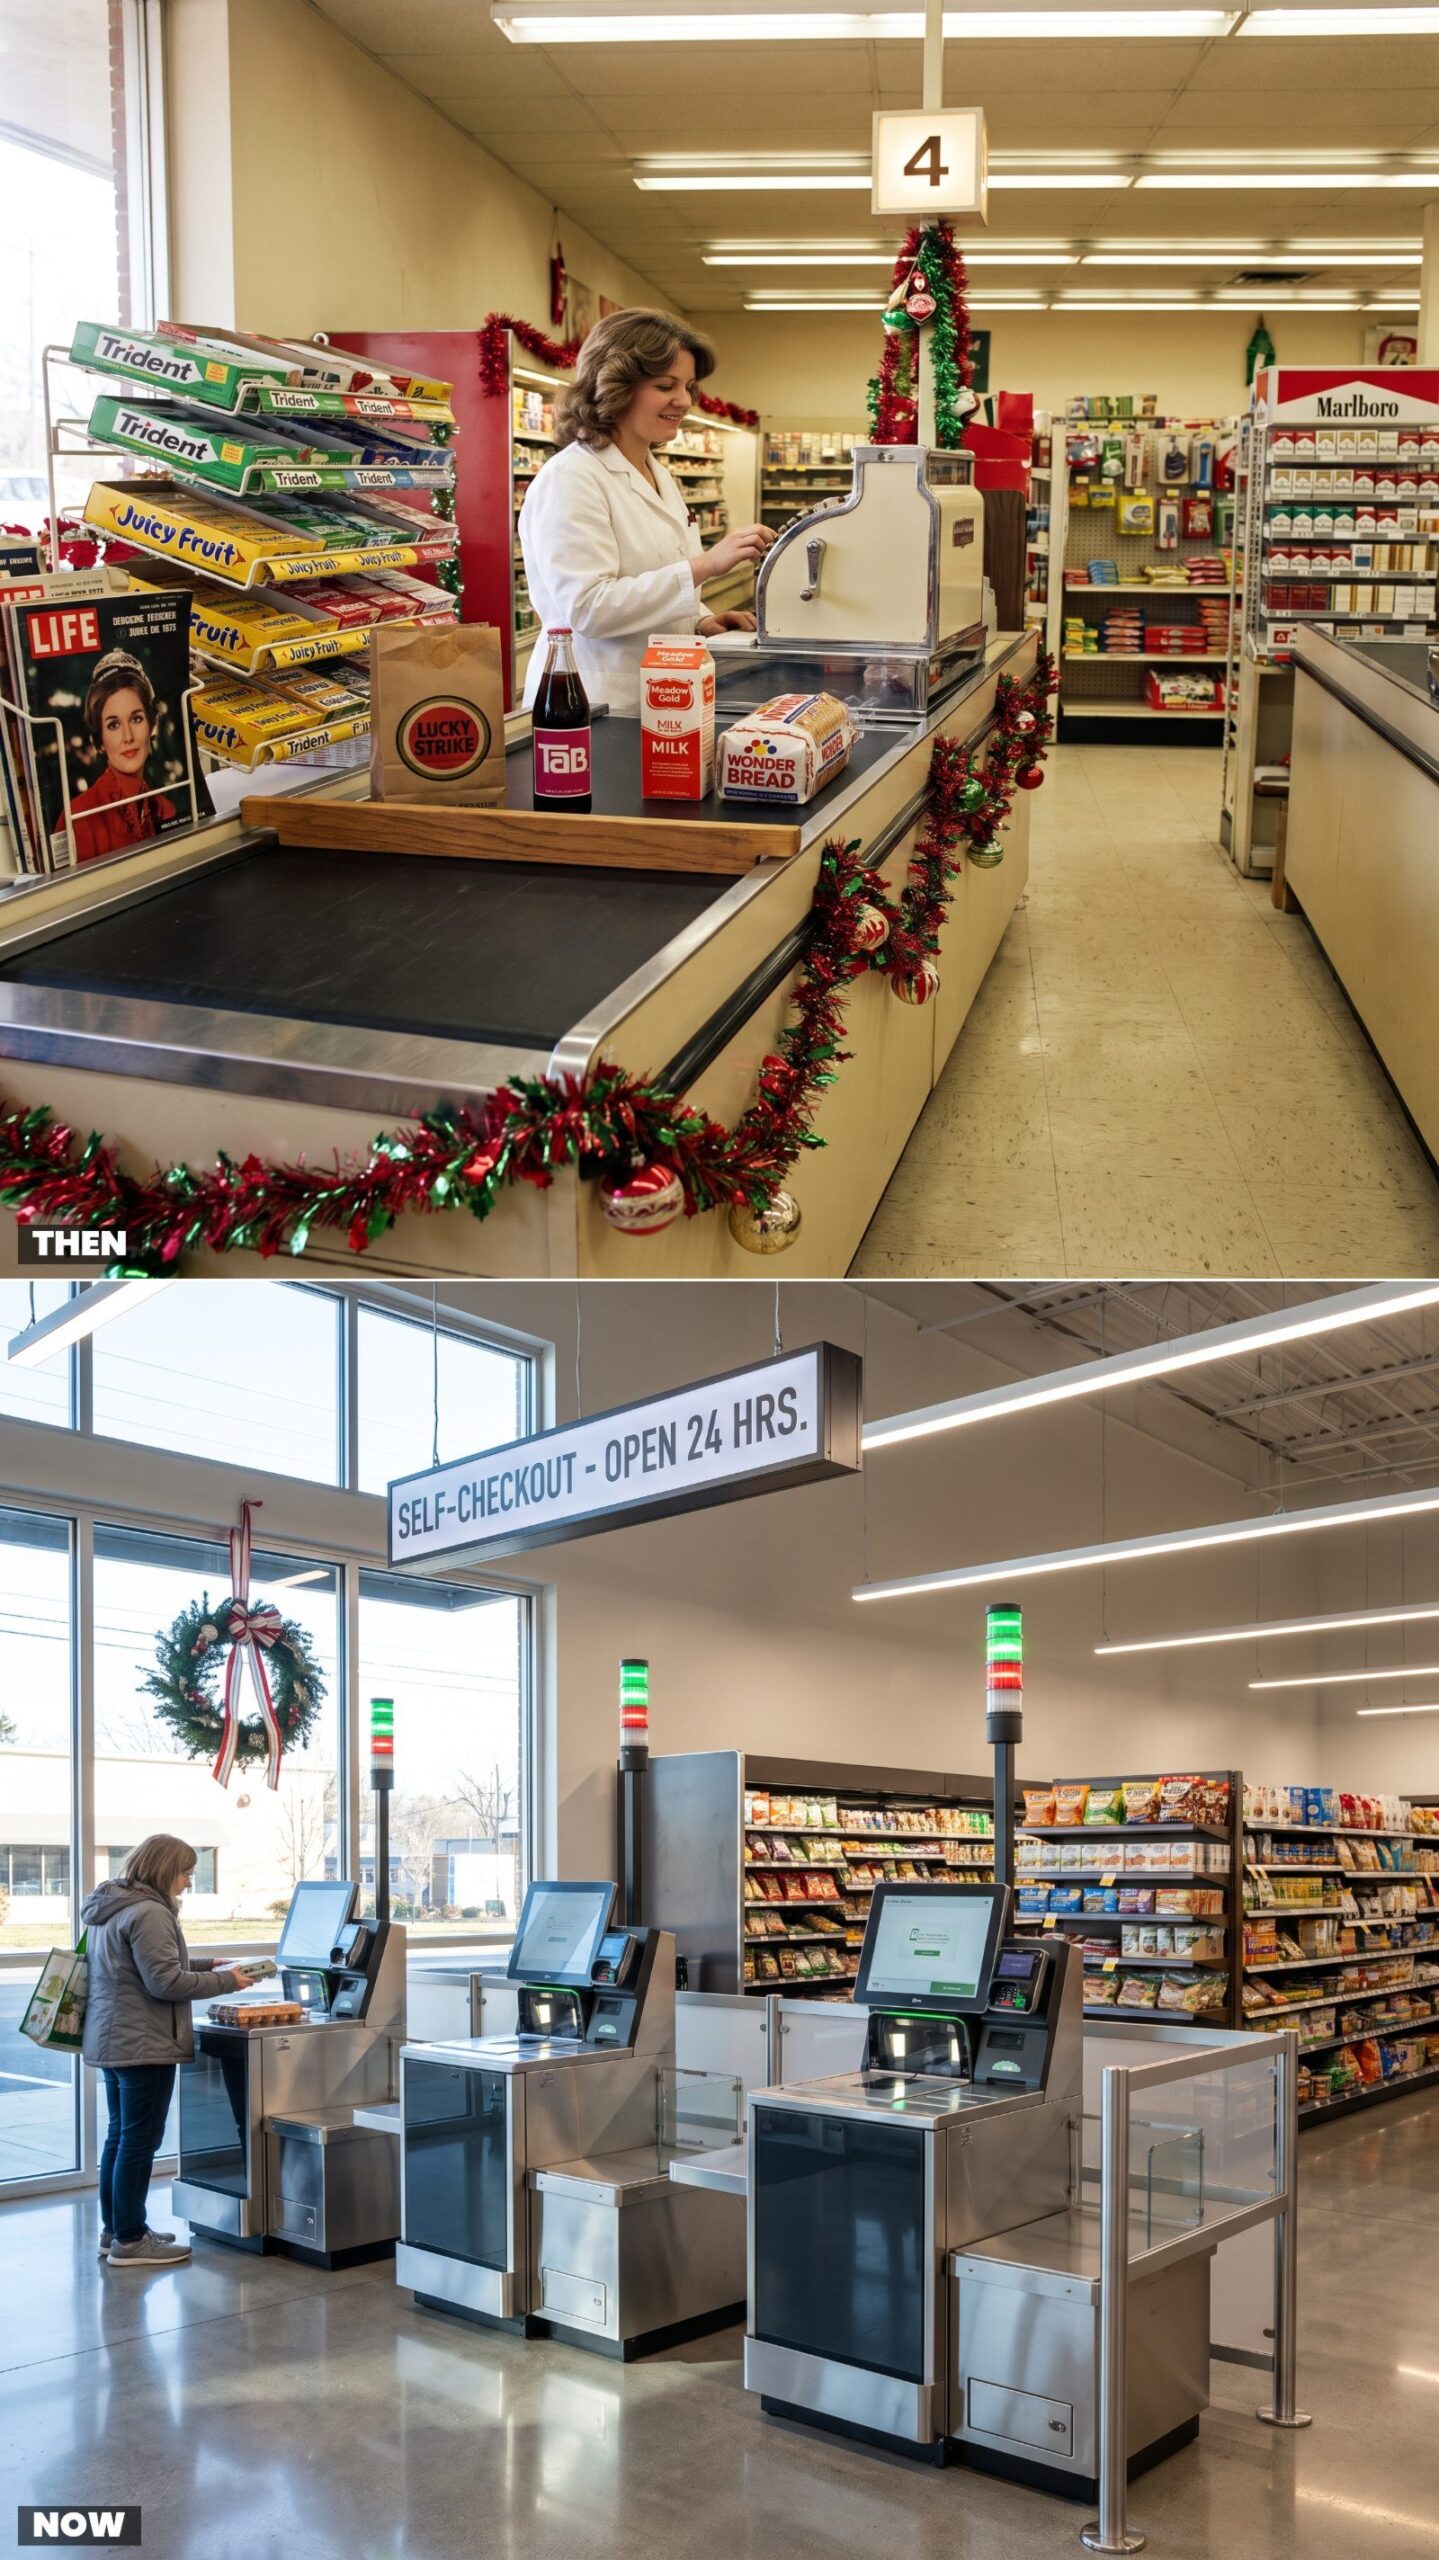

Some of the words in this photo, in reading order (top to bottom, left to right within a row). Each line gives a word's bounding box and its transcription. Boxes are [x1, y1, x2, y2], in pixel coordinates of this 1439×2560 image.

[903, 135, 949, 187] 4
[102, 335, 194, 382] Trident
[271, 392, 316, 408] Trident
[357, 400, 393, 414] Trident
[1316, 394, 1399, 418] Marlboro
[119, 411, 209, 461] Trident
[275, 470, 319, 486] Trident
[357, 471, 393, 485] Trident
[116, 504, 177, 545] Juicy
[177, 526, 237, 566] Fruit
[288, 561, 313, 575] Juicy
[313, 558, 337, 572] Fruit
[358, 554, 383, 568] Juicy
[382, 551, 404, 564] Fruit
[30, 611, 98, 655] LIFE
[288, 644, 316, 661] Juicy
[315, 640, 340, 657] Fruit
[651, 684, 689, 695] Meadow
[658, 694, 681, 703] Gold
[416, 719, 472, 738] LUCKY
[287, 731, 330, 755] Trident
[414, 737, 475, 756] STRIKE
[652, 741, 689, 755] MILK
[727, 753, 796, 771] WONDER
[727, 768, 796, 789] BREAD
[398, 1451, 578, 1540] SELF-CHECKOUT
[604, 1421, 678, 1483] OPEN
[686, 1408, 723, 1461] 24
[732, 1385, 808, 1449] HRS.
